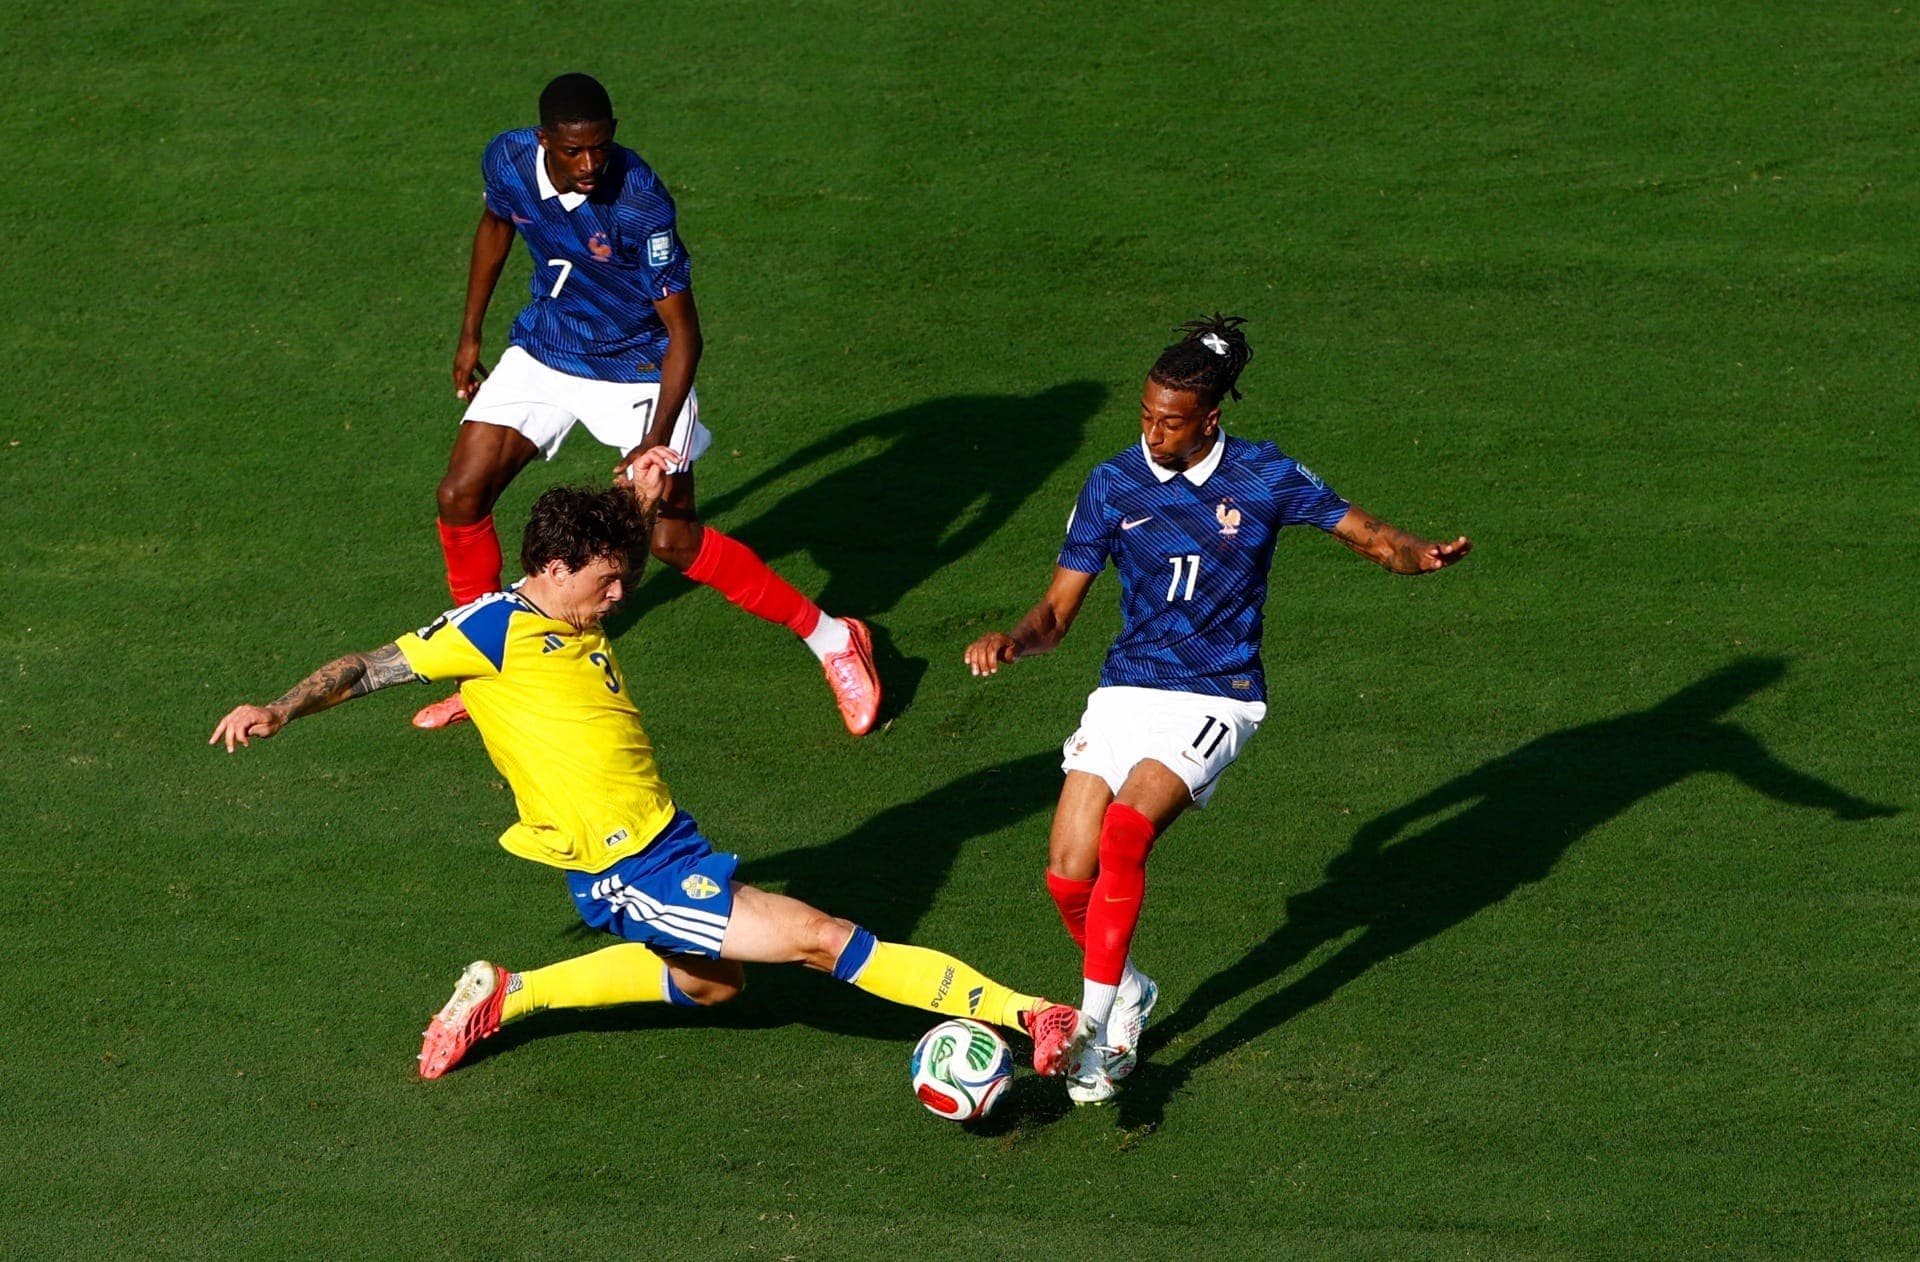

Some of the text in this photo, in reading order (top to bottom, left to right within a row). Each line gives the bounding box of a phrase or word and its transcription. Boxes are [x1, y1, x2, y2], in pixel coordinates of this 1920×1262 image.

[548, 259, 572, 298] 7
[633, 398, 653, 444] 7
[1167, 555, 1200, 602] 11
[589, 652, 620, 694] 3
[1192, 715, 1230, 760] 11
[931, 965, 955, 1008] SVERIGE
